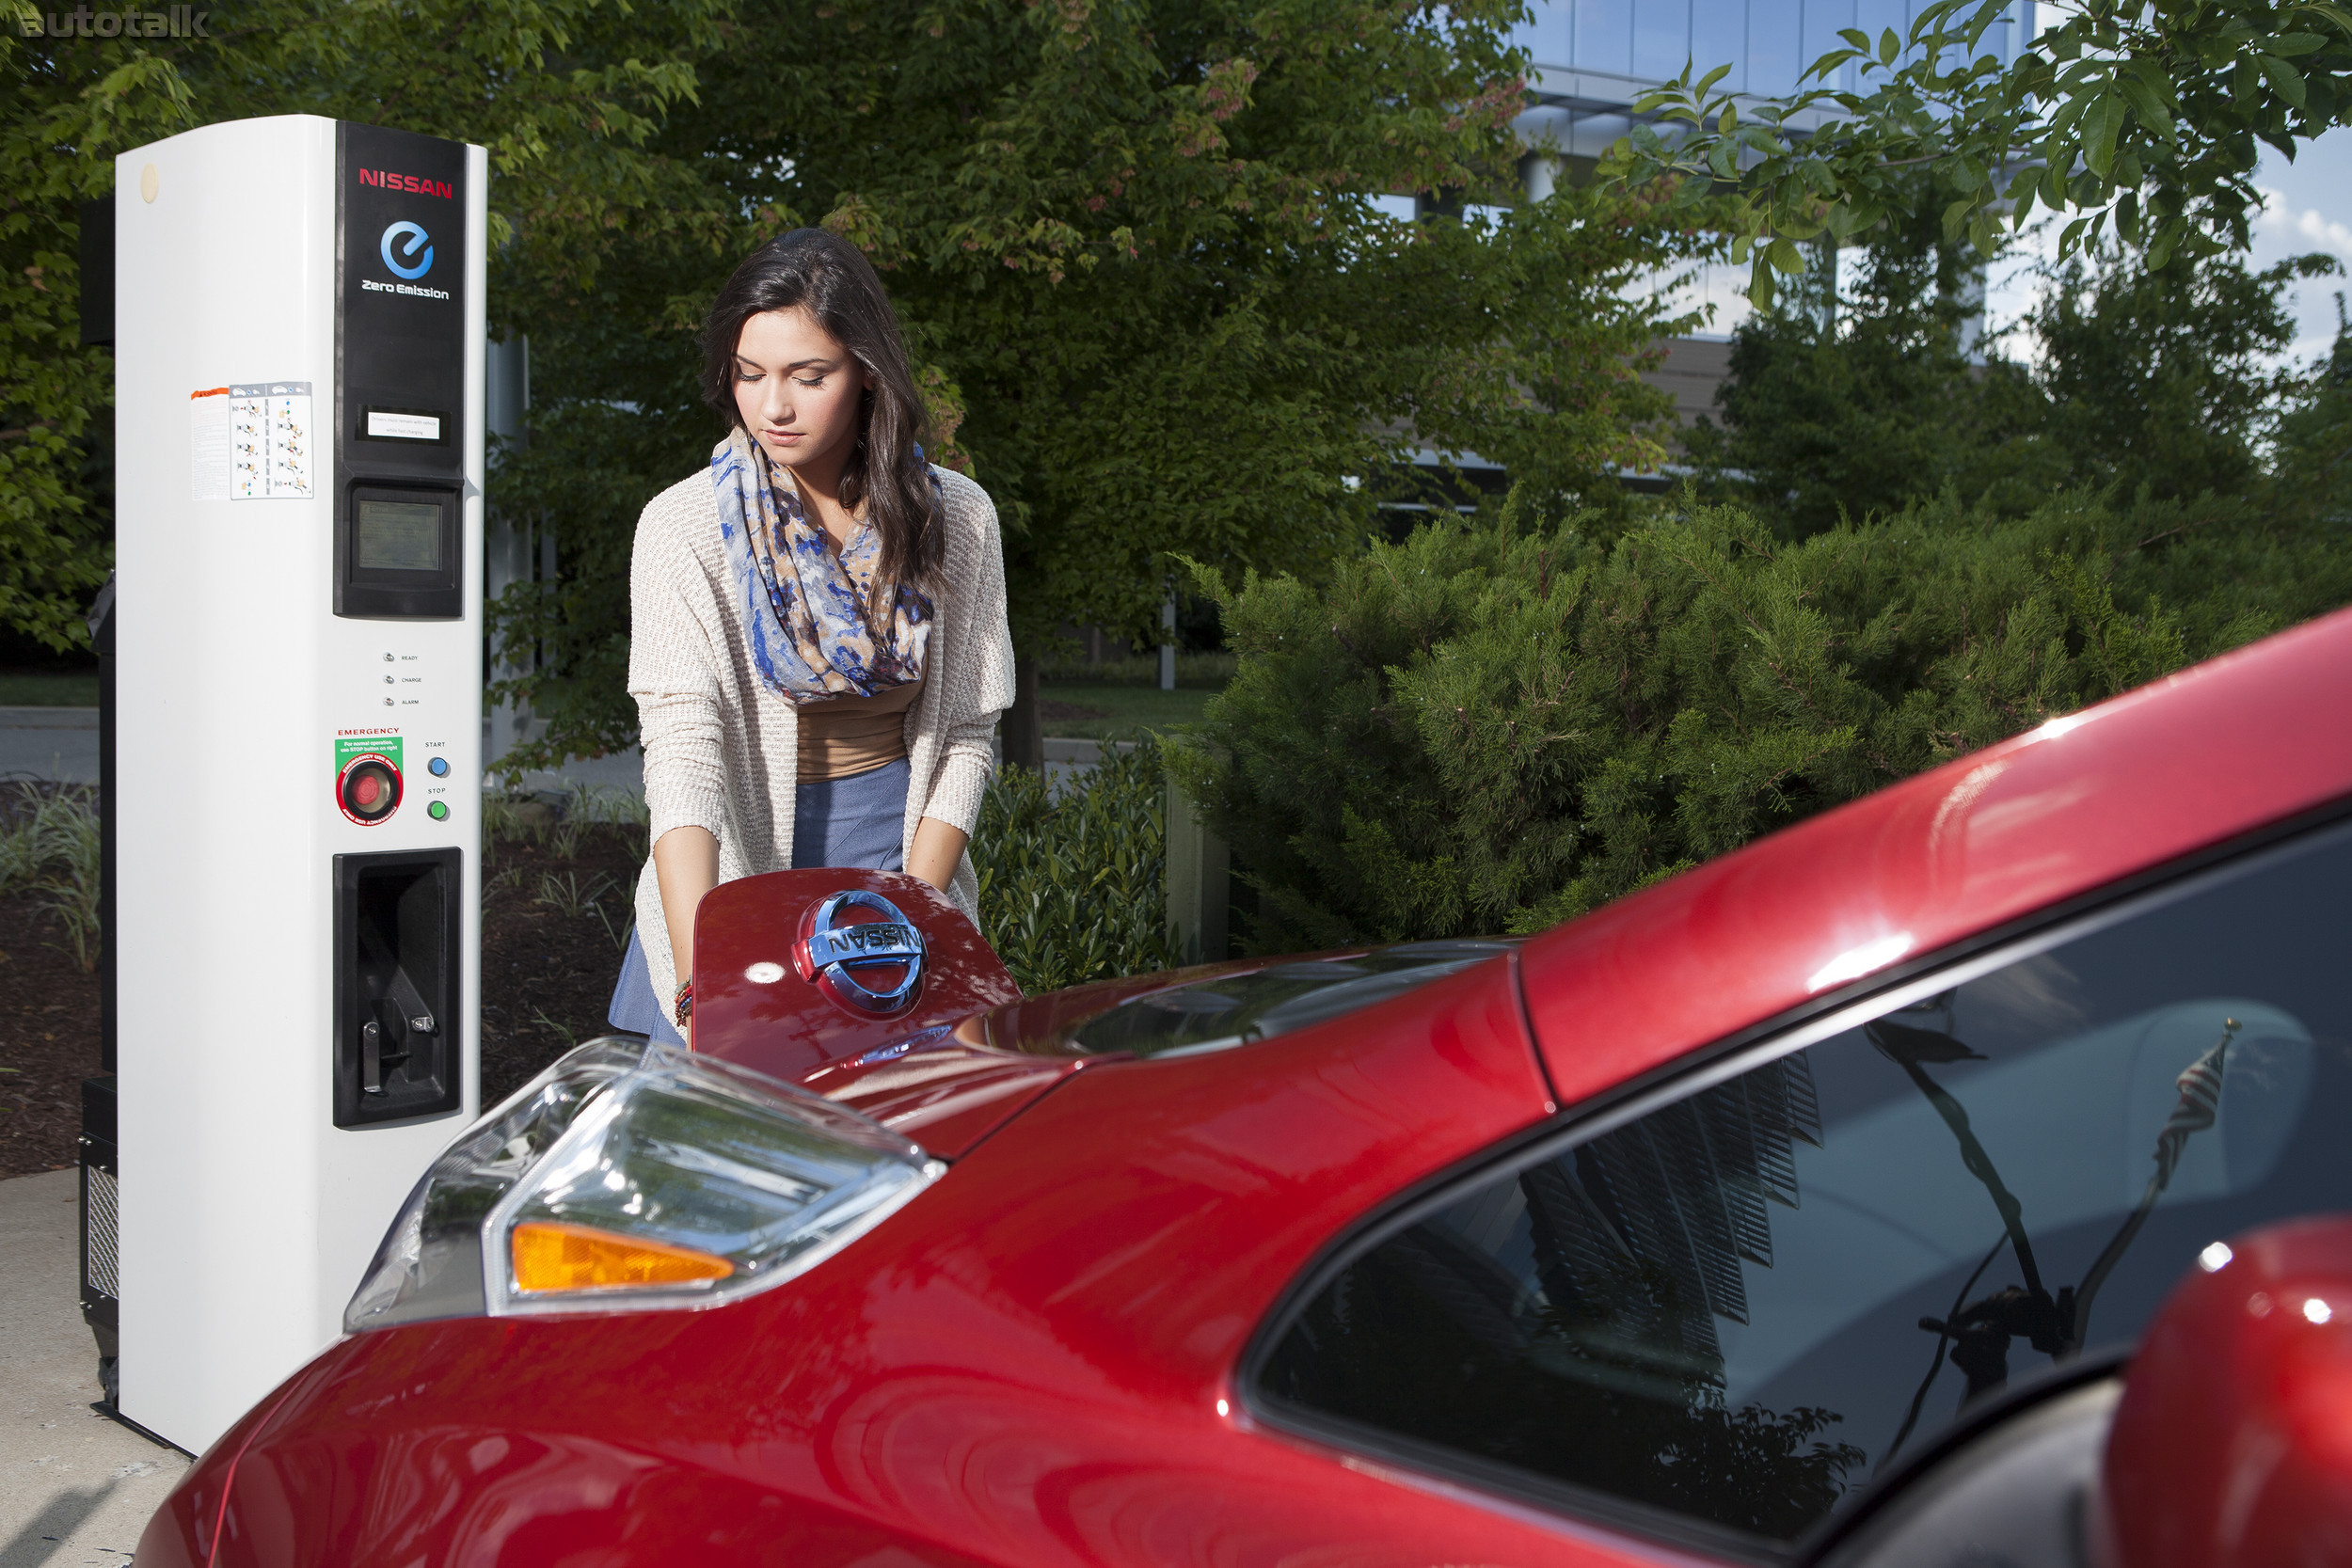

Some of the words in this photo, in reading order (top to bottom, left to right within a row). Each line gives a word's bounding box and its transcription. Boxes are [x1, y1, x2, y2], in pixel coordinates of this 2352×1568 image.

[359, 167, 452, 199] NISSAN
[361, 279, 395, 293] Zero
[396, 284, 450, 300] Emission
[338, 727, 400, 736] EMERGENCY
[342, 754, 373, 773] EMERGENCY
[385, 759, 398, 771] ONLY
[828, 928, 920, 955] NISSAN
